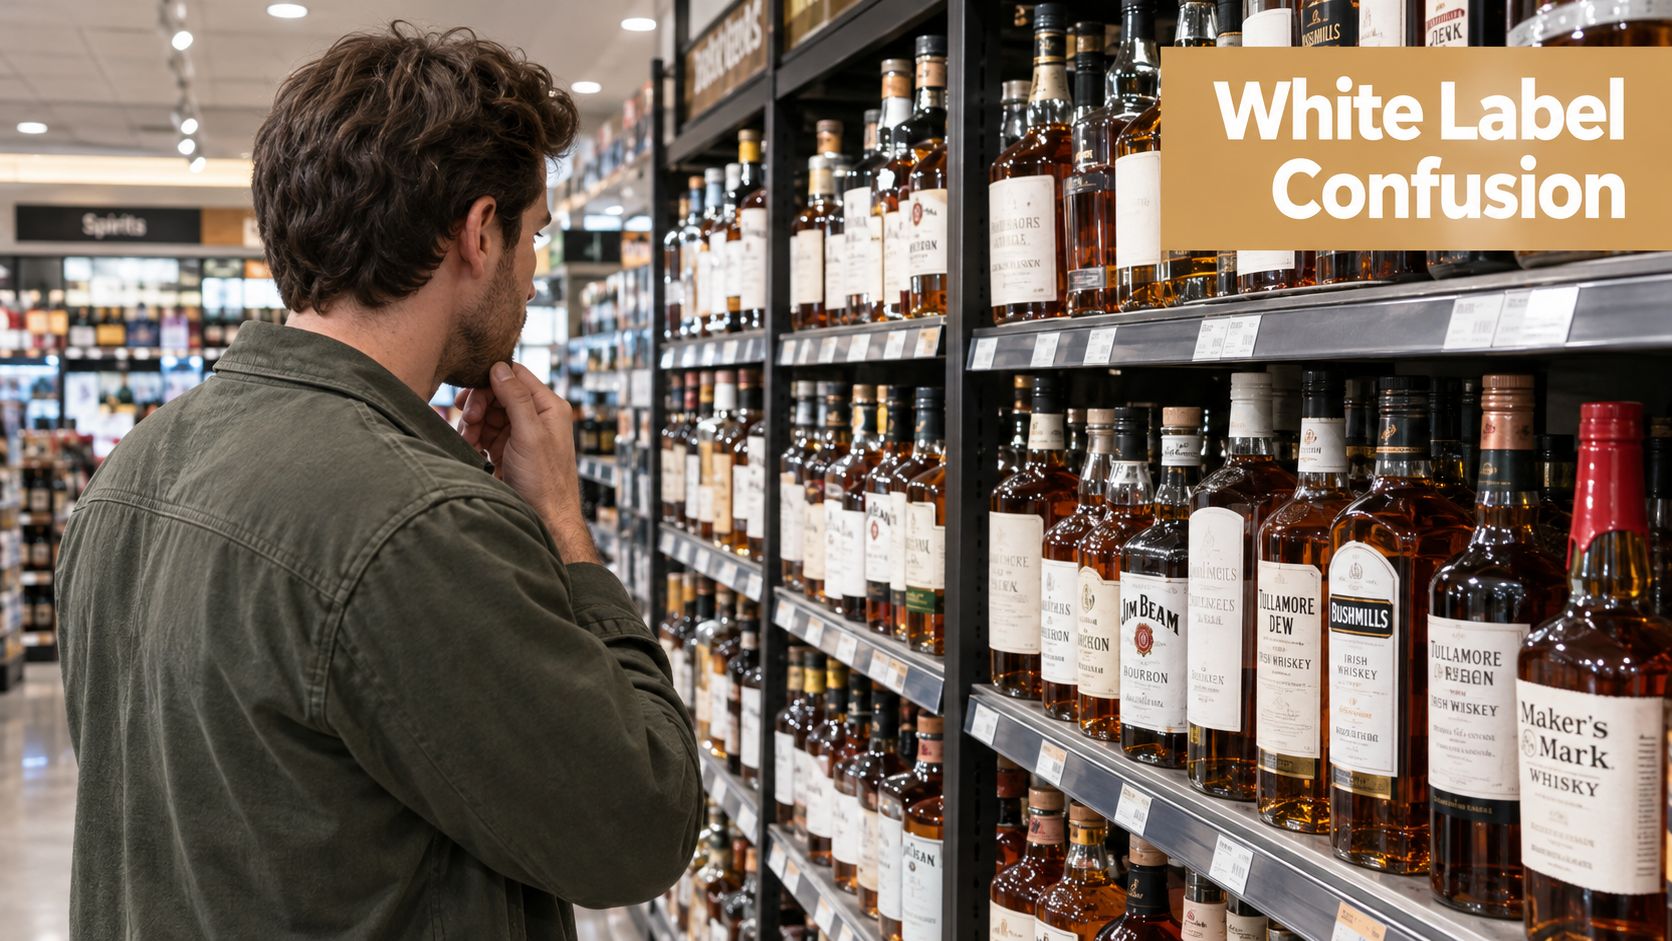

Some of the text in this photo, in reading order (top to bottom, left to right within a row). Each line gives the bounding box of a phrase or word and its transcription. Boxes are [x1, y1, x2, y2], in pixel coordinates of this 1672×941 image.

[82, 213, 147, 239] Spirits
[1259, 588, 1316, 616] TULLAMORE
[1269, 614, 1294, 636] DEW
[1344, 653, 1368, 667] IRISH
[1431, 639, 1503, 667] TULLAMORE
[1123, 665, 1168, 684] BOURBON
[1521, 699, 1608, 739] Maker's
[1530, 767, 1600, 798] WHISKY
